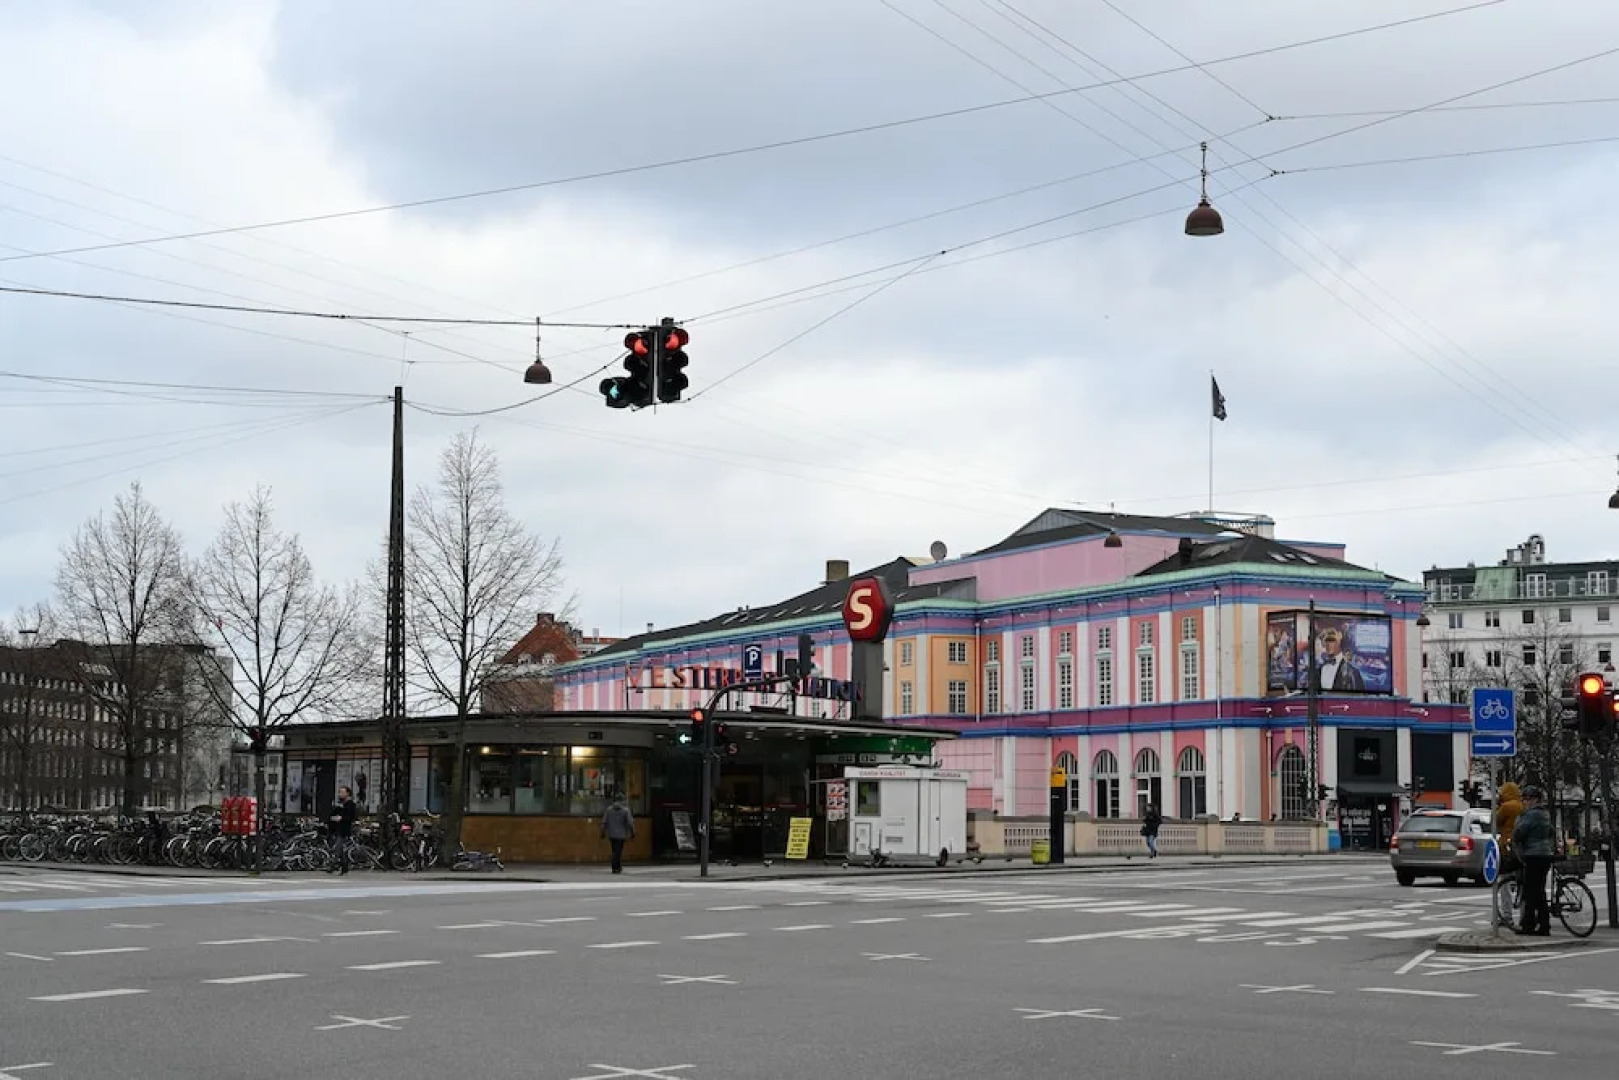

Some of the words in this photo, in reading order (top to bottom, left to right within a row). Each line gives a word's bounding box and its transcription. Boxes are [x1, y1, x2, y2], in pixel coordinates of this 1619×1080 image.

[850, 587, 873, 631] S
[749, 651, 759, 666] P
[627, 665, 778, 692] VESTERPRT
